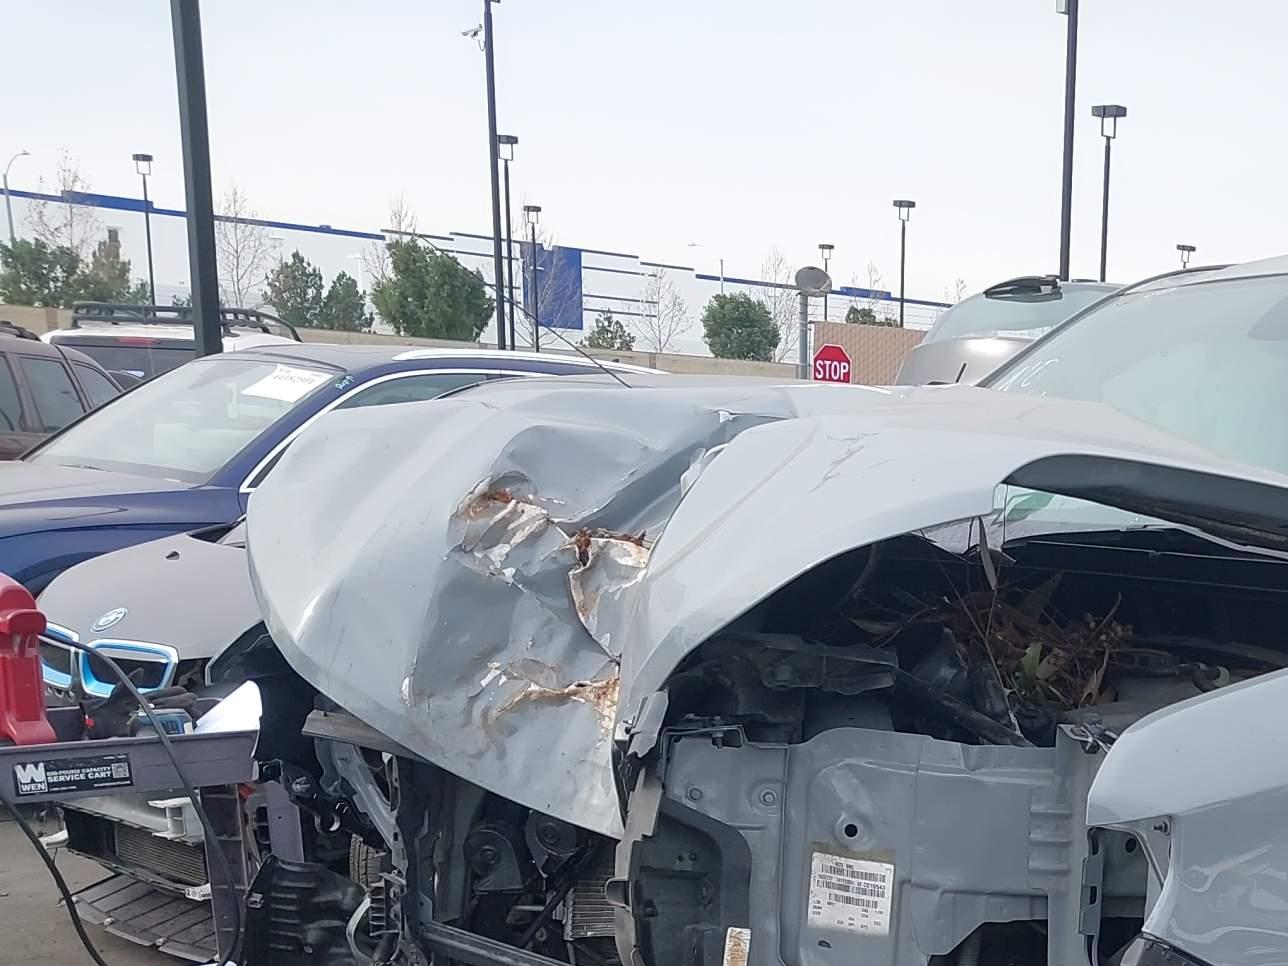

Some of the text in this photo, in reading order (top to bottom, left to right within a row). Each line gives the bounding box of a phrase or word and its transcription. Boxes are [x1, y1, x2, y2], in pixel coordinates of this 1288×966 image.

[815, 360, 849, 380] STOP
[47, 771, 112, 783] SERVICE CART
[21, 782, 46, 792] WEN
